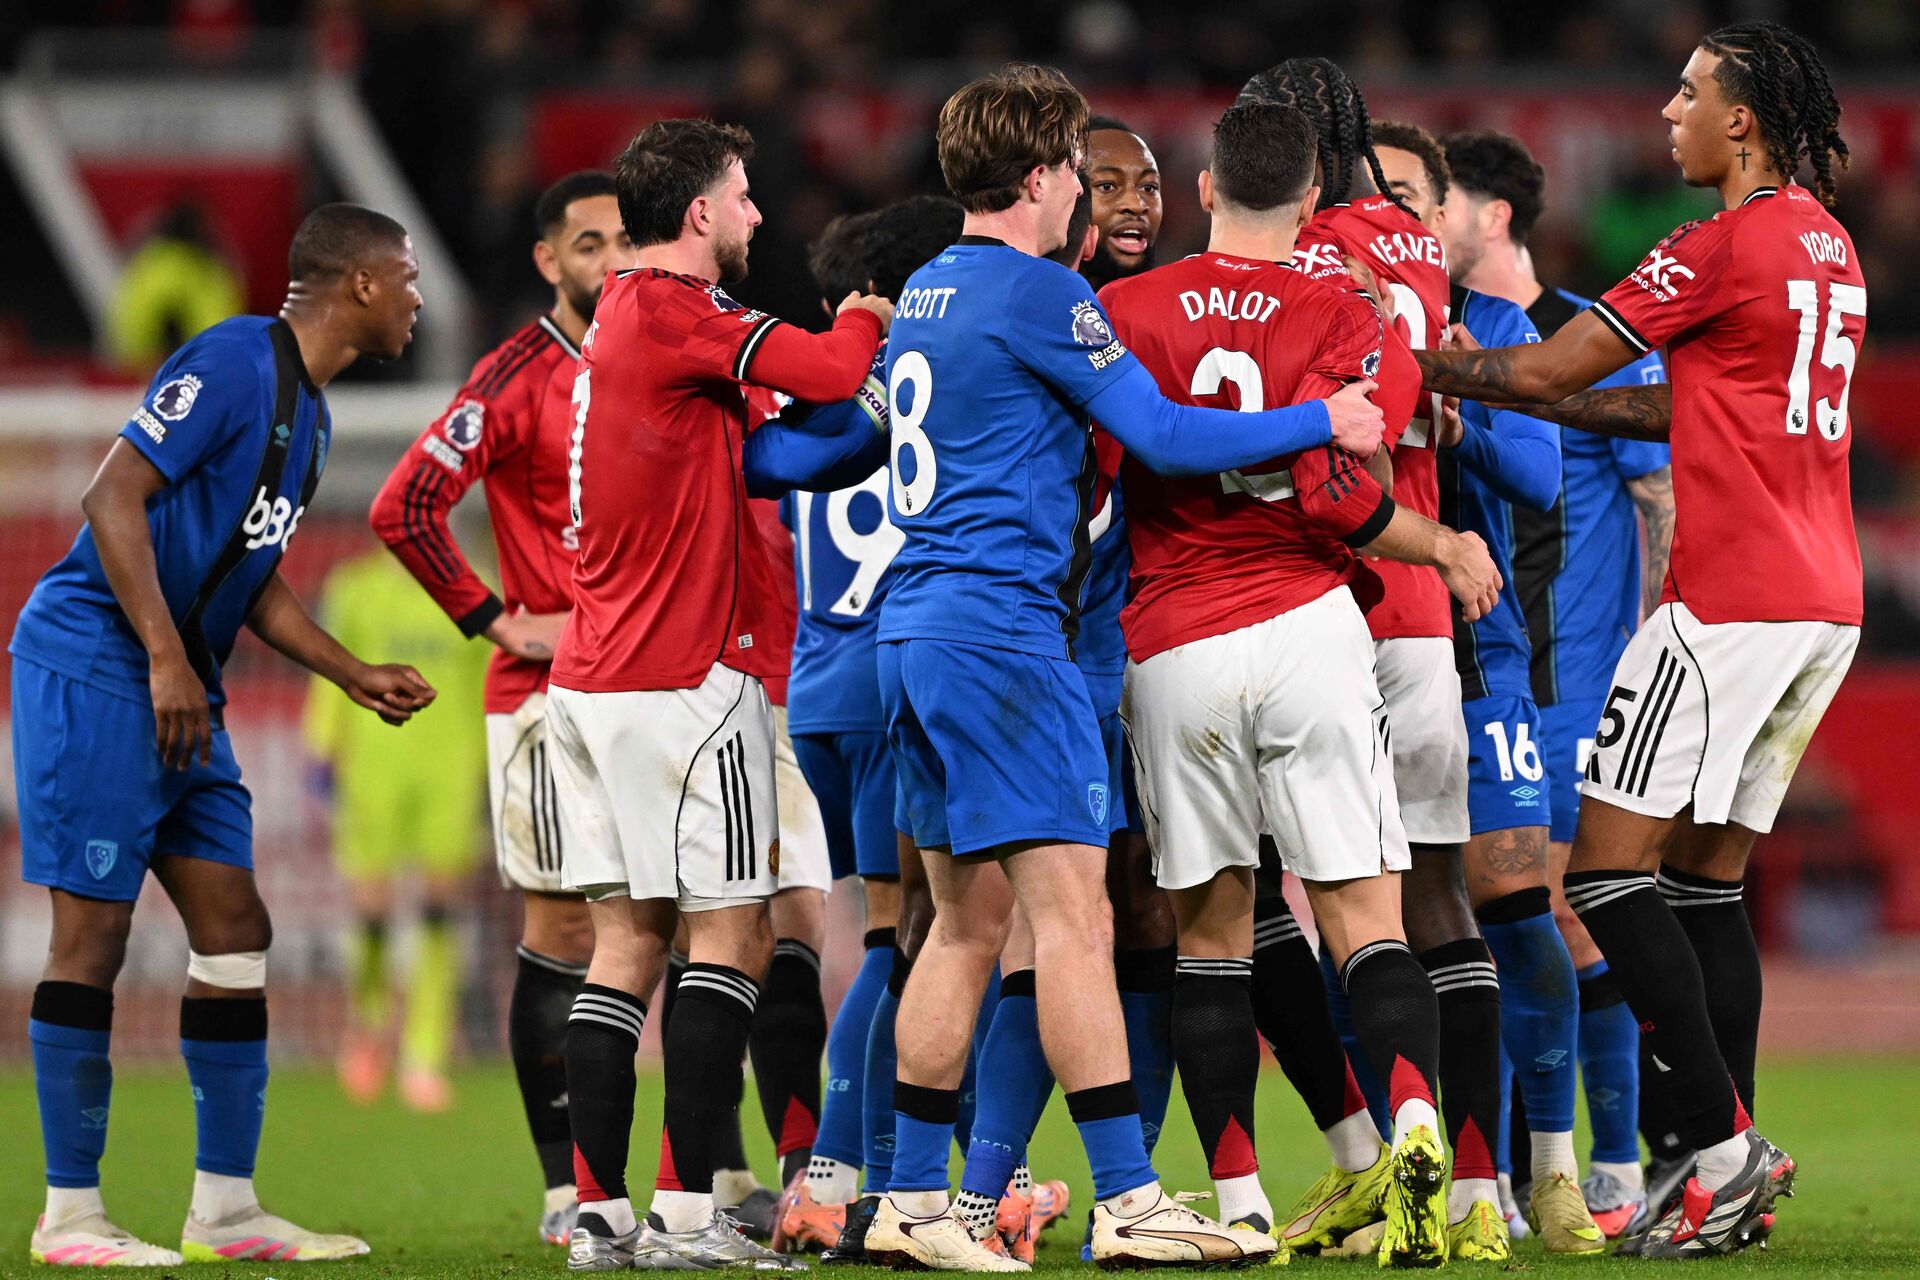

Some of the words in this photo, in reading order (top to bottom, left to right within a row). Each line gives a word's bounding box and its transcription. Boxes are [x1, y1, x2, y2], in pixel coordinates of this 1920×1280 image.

[1798, 230, 1847, 267] YORO
[895, 287, 957, 319] SCOTT
[1179, 287, 1281, 323] DALOT
[1783, 279, 1867, 442] 15
[855, 385, 889, 426] ptain
[889, 350, 937, 517] 8
[796, 465, 906, 617] 19
[1595, 685, 1638, 749] 5
[1484, 721, 1543, 782] 16
